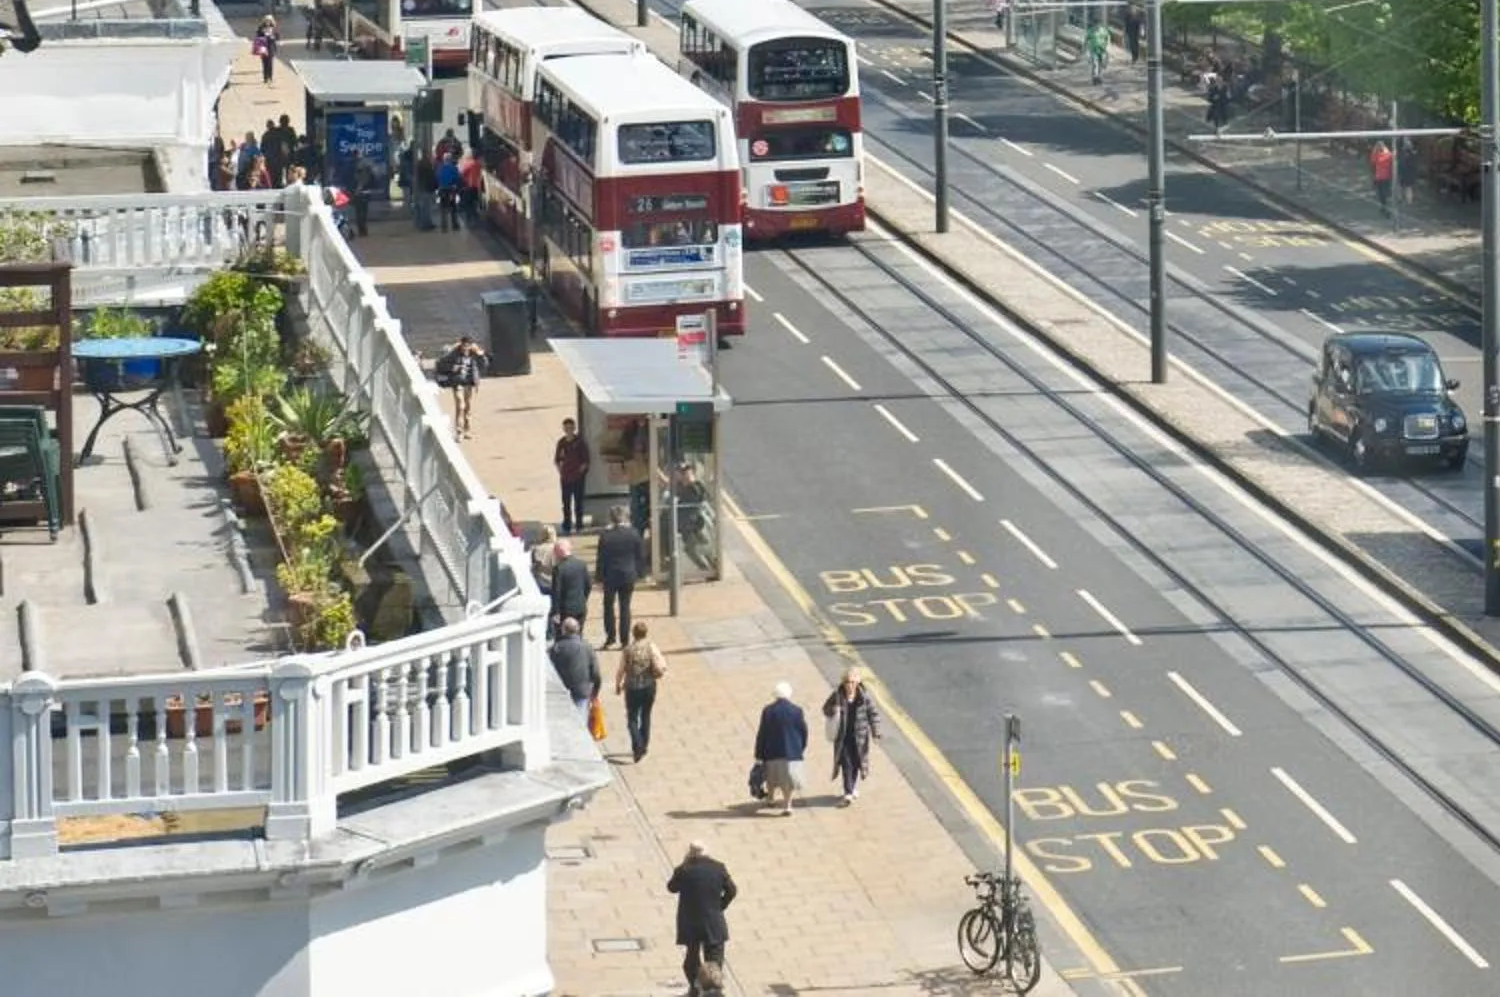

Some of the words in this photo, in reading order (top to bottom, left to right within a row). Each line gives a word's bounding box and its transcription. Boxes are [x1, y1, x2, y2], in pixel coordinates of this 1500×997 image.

[637, 198, 653, 211] 26
[818, 563, 956, 593] BUS
[828, 591, 998, 627] STOP
[1011, 779, 1180, 821] BUS
[1024, 823, 1237, 874] STOP
